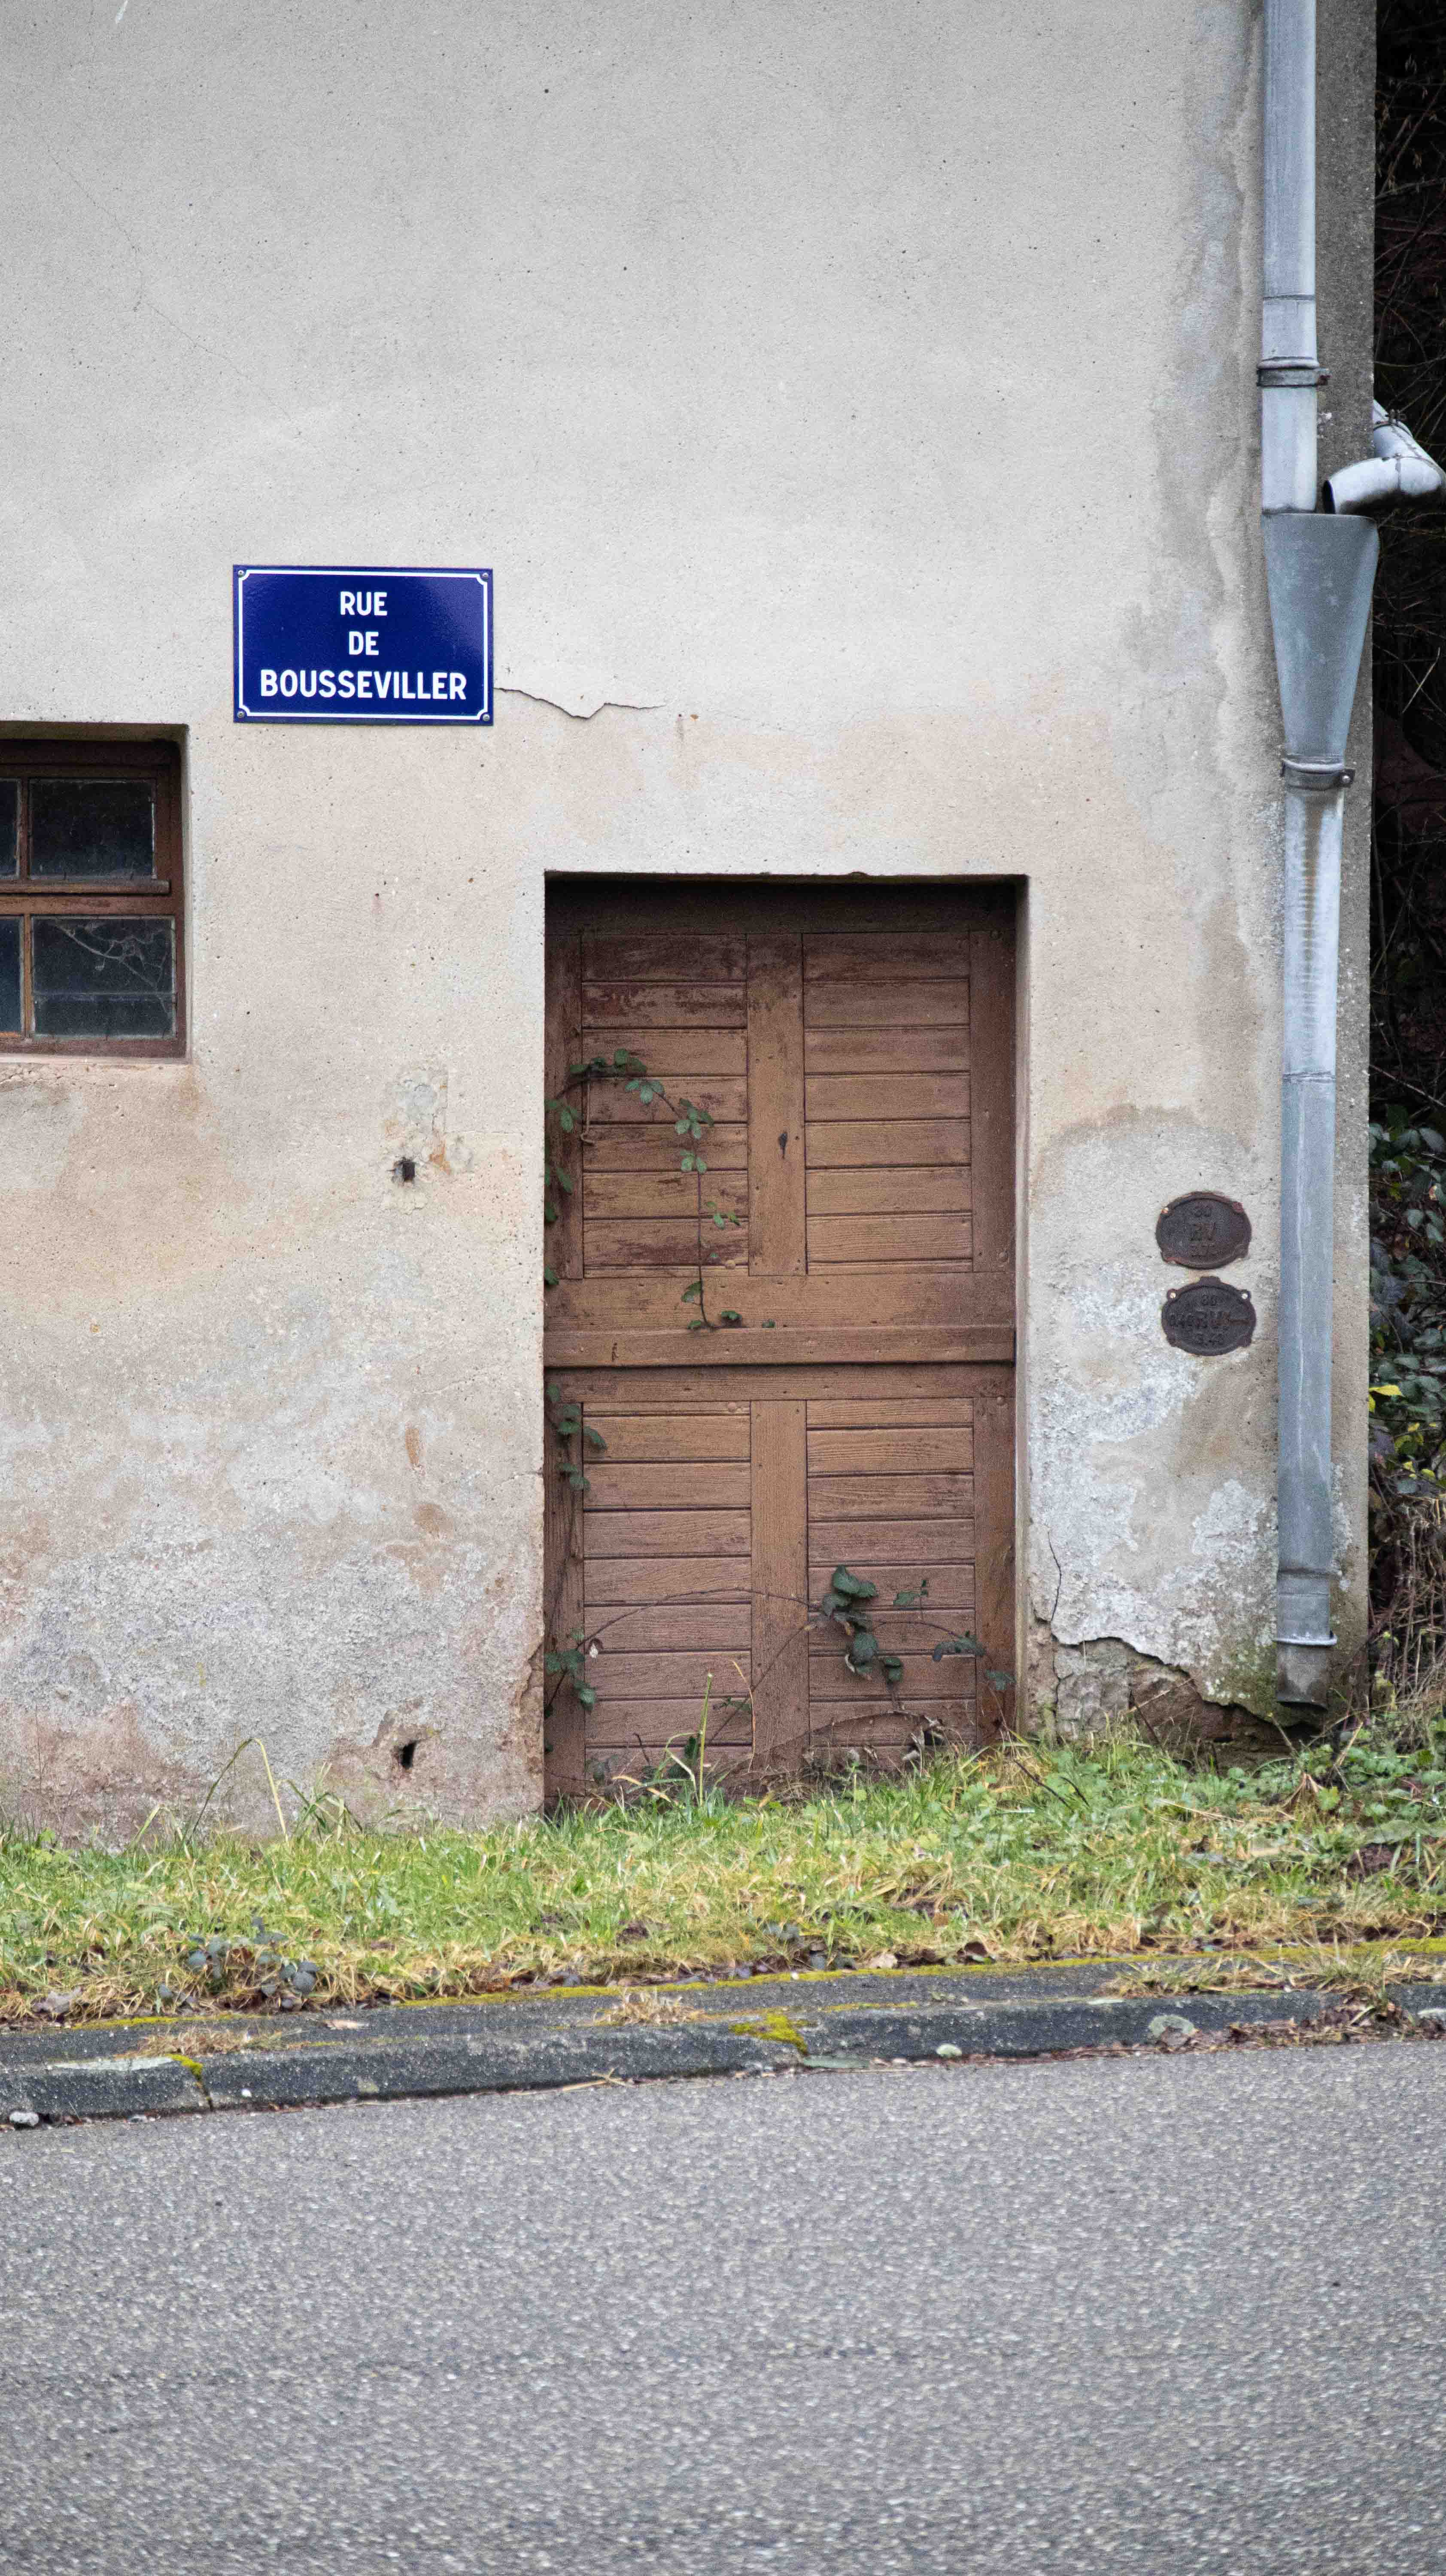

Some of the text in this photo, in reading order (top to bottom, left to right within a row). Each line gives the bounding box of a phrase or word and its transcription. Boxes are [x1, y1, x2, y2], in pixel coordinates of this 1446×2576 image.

[340, 591, 387, 616] RUE
[349, 631, 379, 656] DE
[260, 669, 467, 700] BOUSSEVILLER
